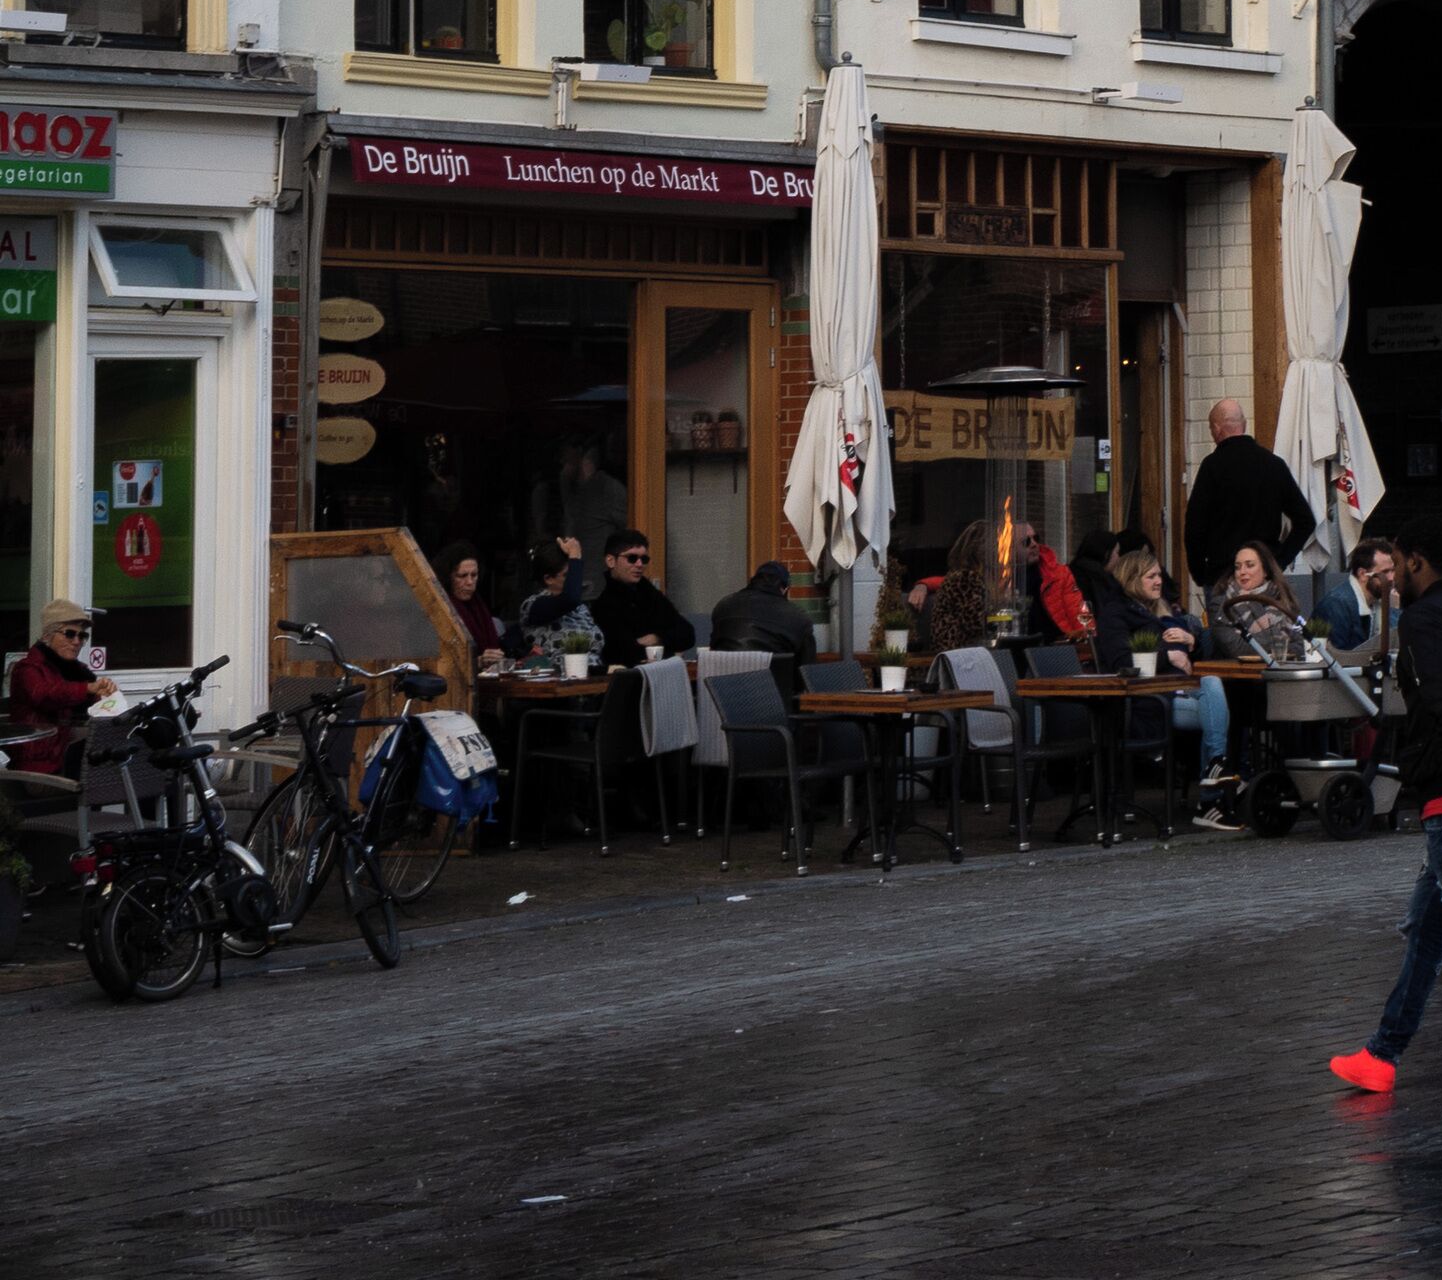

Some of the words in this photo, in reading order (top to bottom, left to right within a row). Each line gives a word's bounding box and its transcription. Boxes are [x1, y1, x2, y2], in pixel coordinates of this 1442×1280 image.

[0, 111, 112, 159] aoz
[364, 144, 398, 173] De
[403, 146, 470, 183] Bruijn
[504, 155, 596, 184] Lunchen
[600, 166, 626, 193] op
[632, 162, 655, 188] de
[657, 165, 720, 193] Markt
[749, 169, 780, 197] De
[329, 369, 371, 384] BRUIJN
[952, 408, 1067, 452] BRIJN
